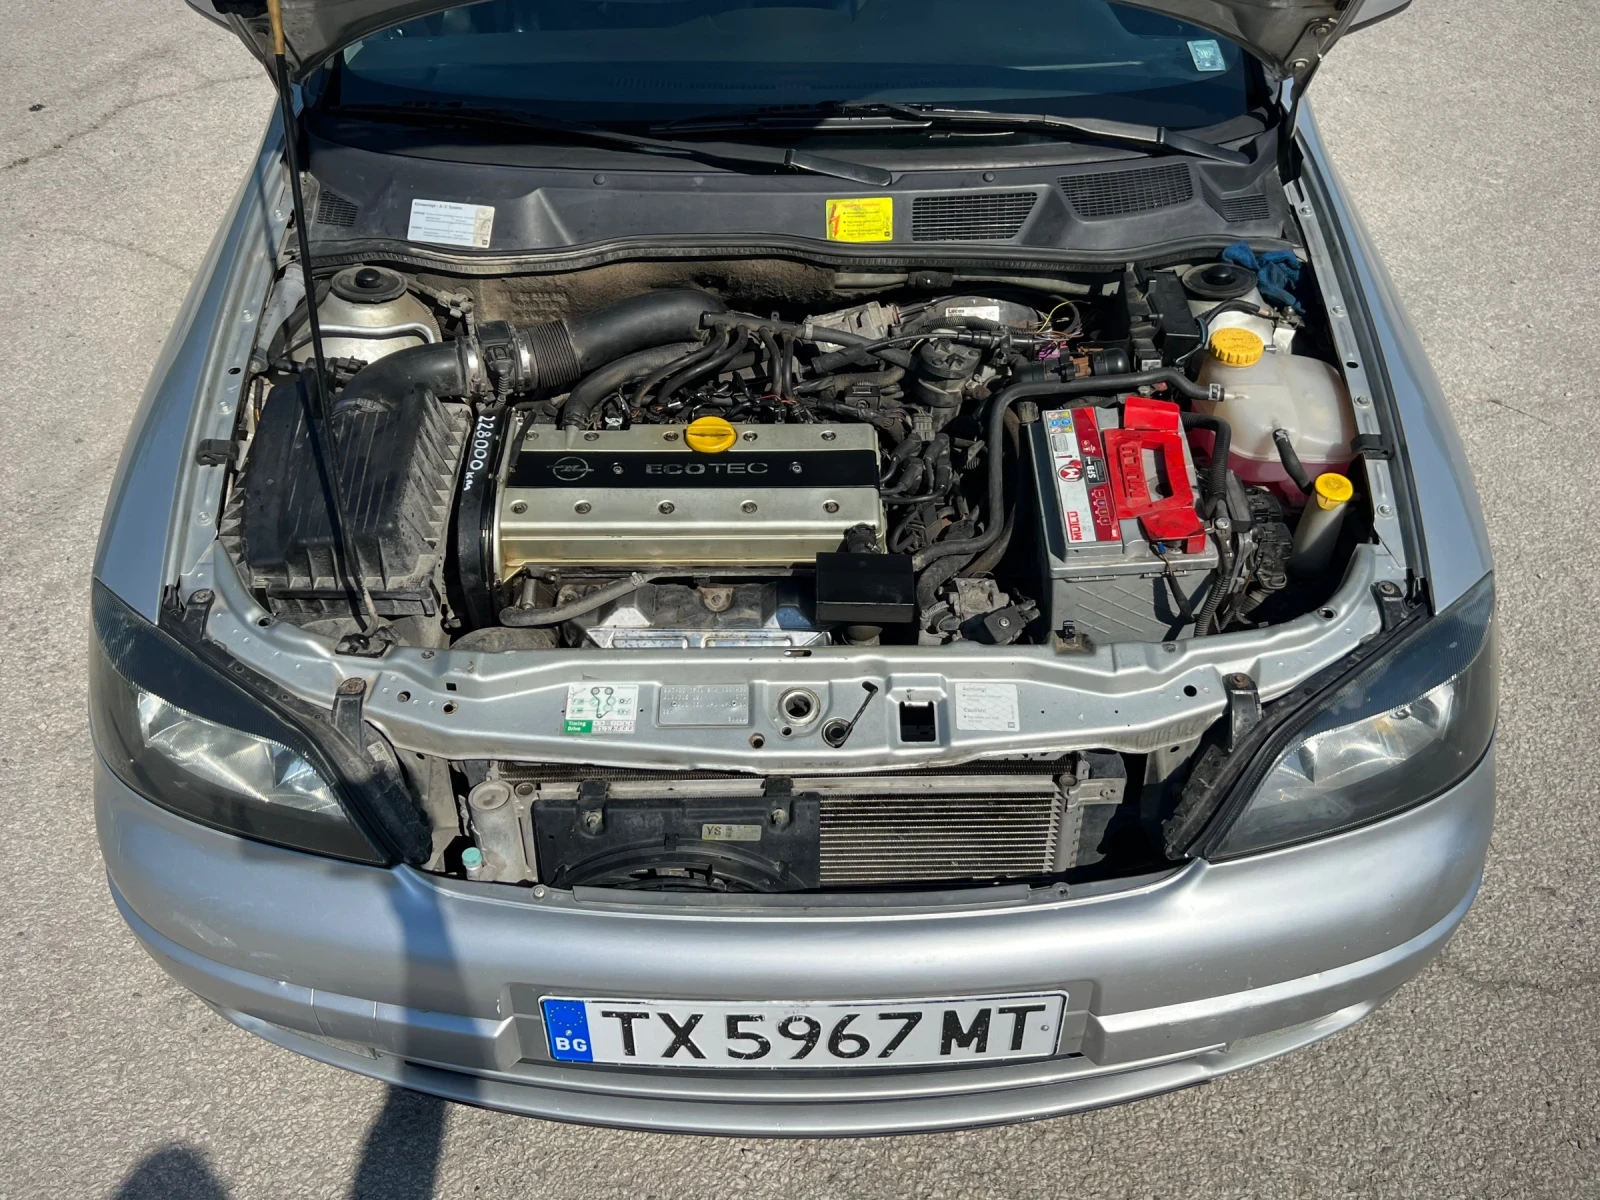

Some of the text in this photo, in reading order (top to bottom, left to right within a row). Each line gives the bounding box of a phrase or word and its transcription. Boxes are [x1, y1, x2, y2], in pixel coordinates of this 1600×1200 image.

[469, 415, 497, 471] 228000
[645, 462, 769, 475] ECOTEC
[1086, 465, 1096, 479] SFB
[706, 826, 722, 836] YS
[601, 1004, 1047, 1060] TX 5967 MT
[555, 1036, 588, 1052] BG
